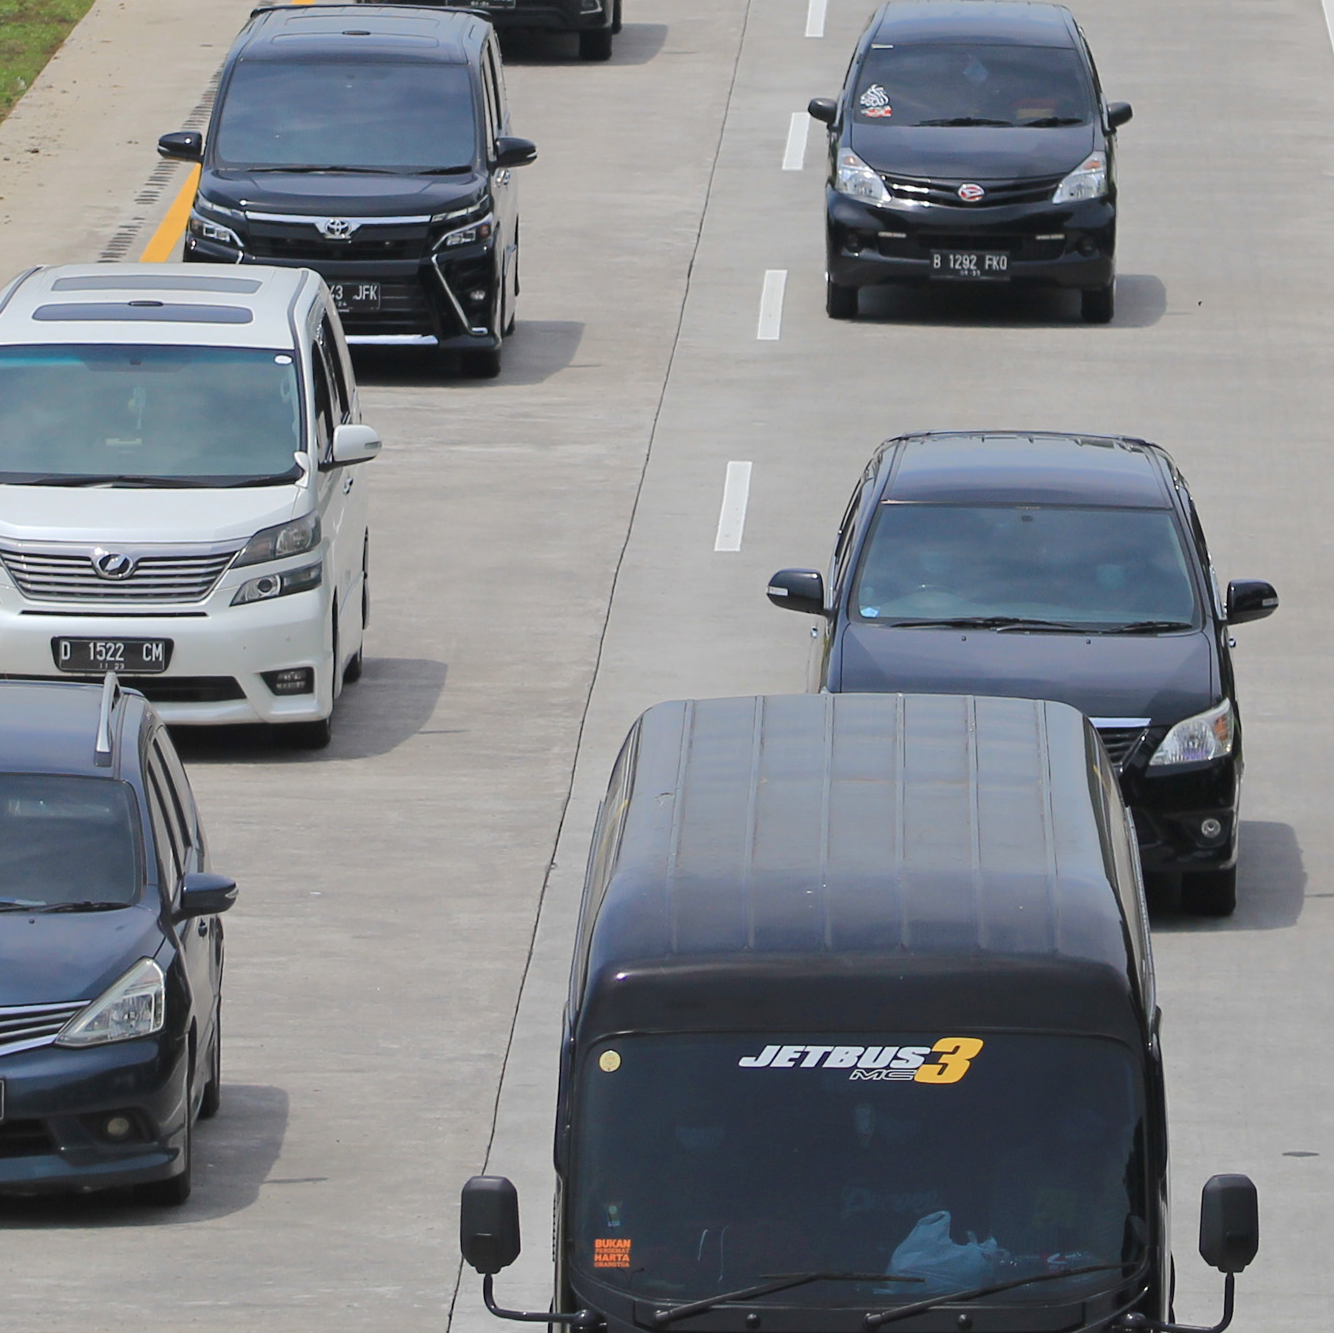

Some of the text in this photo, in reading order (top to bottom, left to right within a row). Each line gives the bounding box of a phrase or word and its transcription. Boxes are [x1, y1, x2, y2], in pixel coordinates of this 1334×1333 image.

[933, 254, 941, 268] B
[949, 254, 977, 270] 1292
[352, 285, 378, 300] JFK
[61, 642, 163, 661] D 1522 CM
[595, 1239, 631, 1248] BUKAN
[595, 1254, 630, 1262] HARTA
